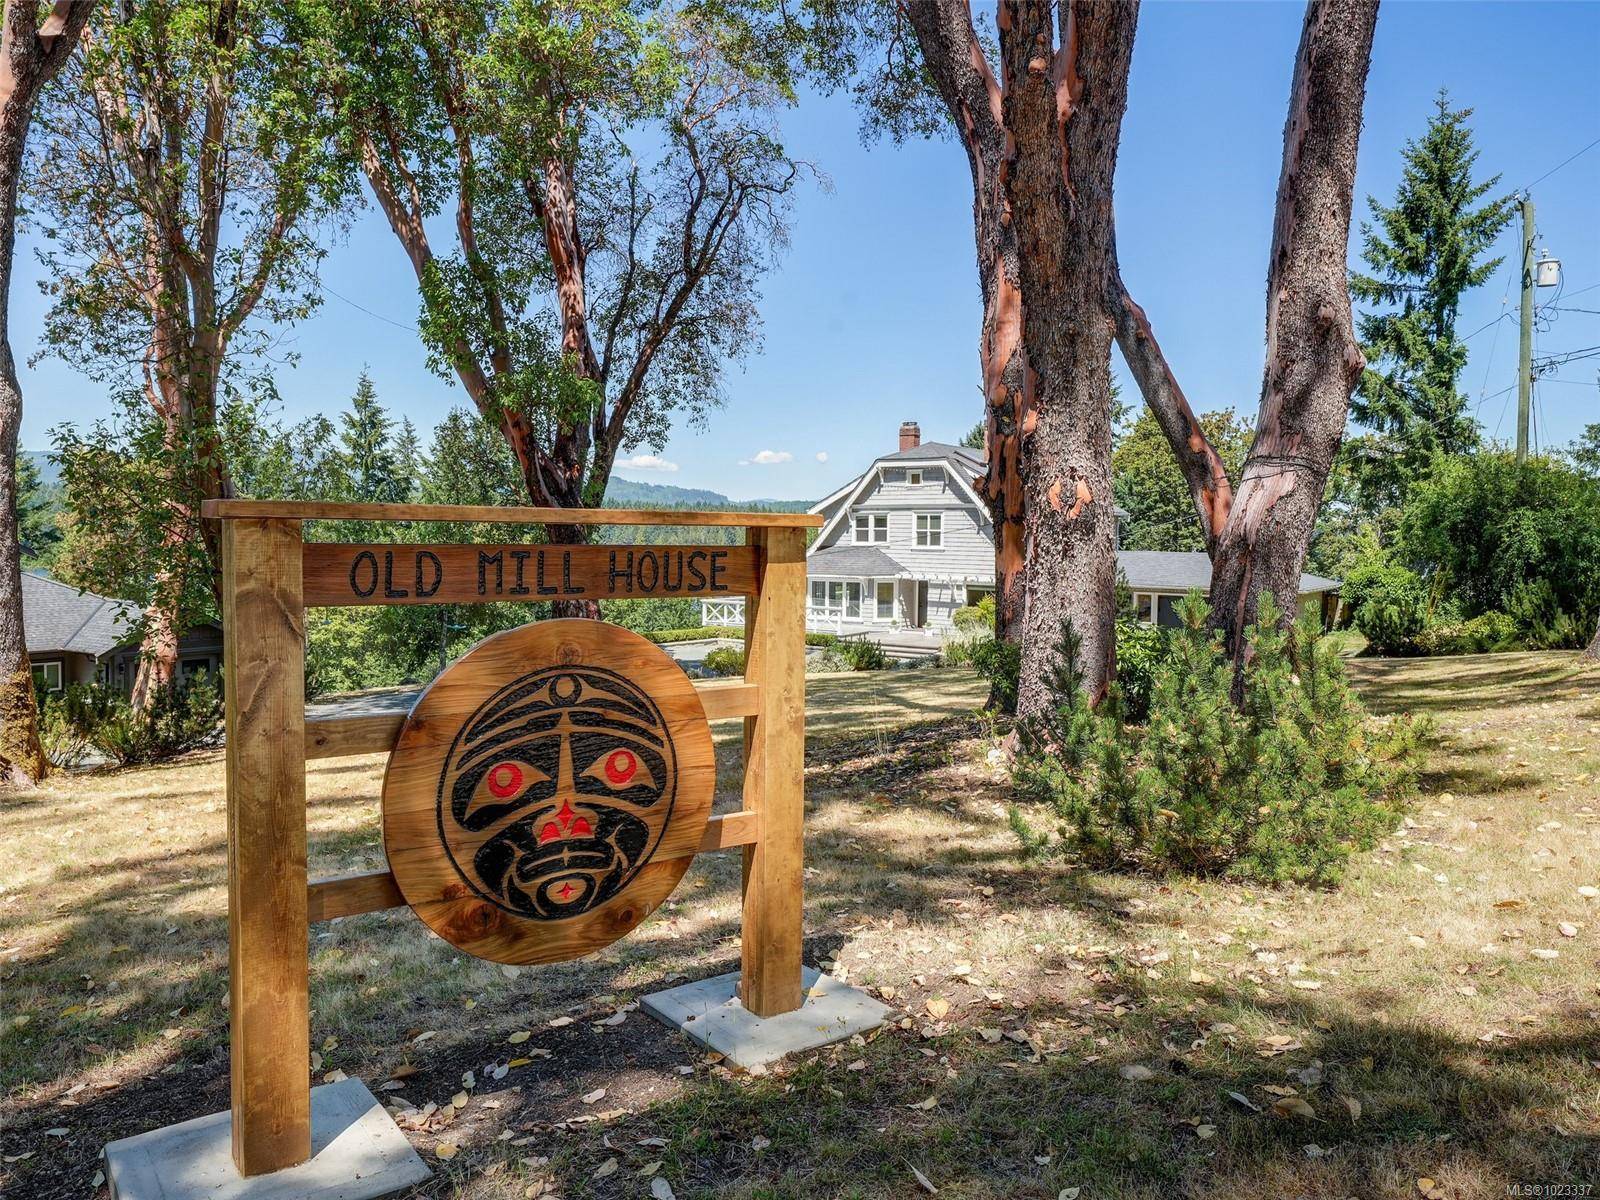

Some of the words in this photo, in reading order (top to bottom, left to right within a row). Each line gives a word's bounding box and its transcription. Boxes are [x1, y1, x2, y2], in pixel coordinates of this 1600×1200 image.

[350, 551, 443, 598] OLD
[477, 551, 585, 595] MILL
[608, 550, 728, 593] HOUSE
